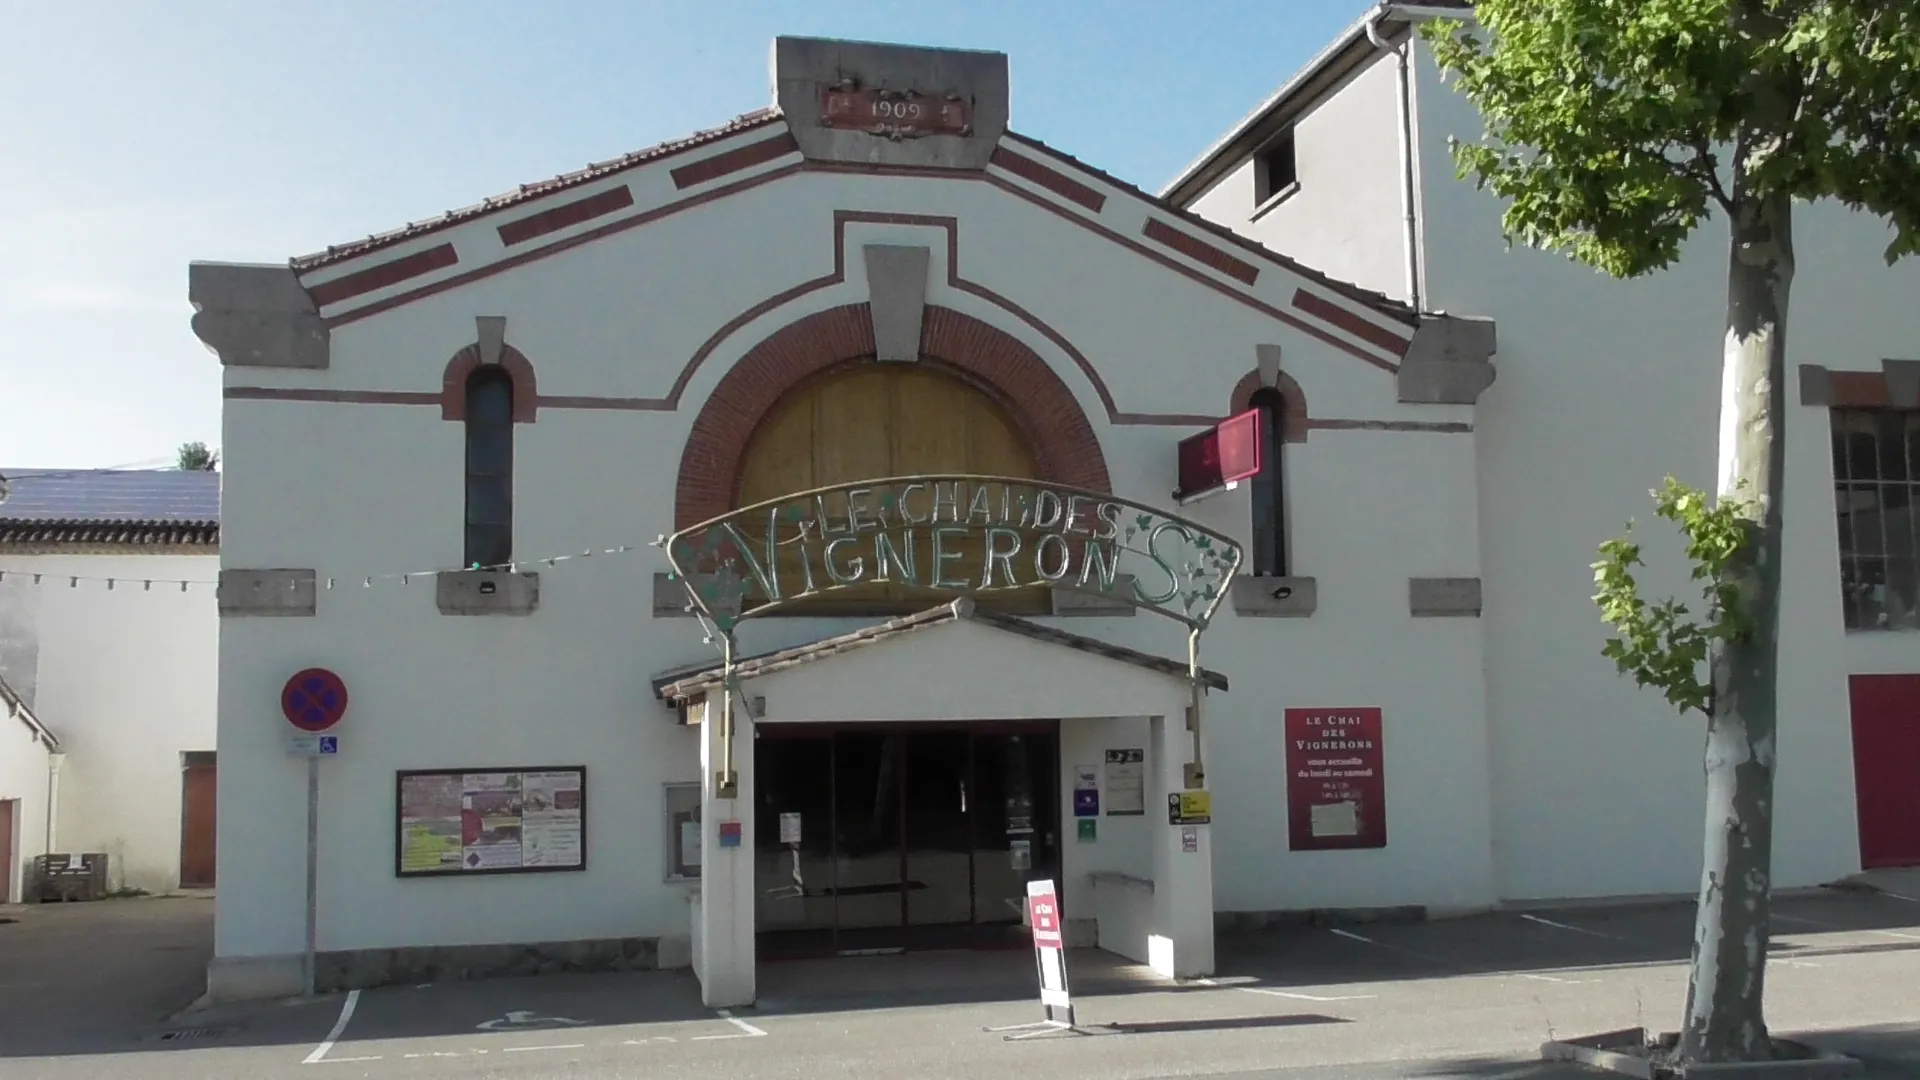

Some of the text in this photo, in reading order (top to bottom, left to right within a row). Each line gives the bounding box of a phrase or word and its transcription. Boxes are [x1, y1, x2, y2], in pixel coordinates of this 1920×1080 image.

[872, 101, 920, 118] 1909
[817, 481, 1123, 540] LE CHAI DES
[722, 507, 1192, 602] VIGNERONS
